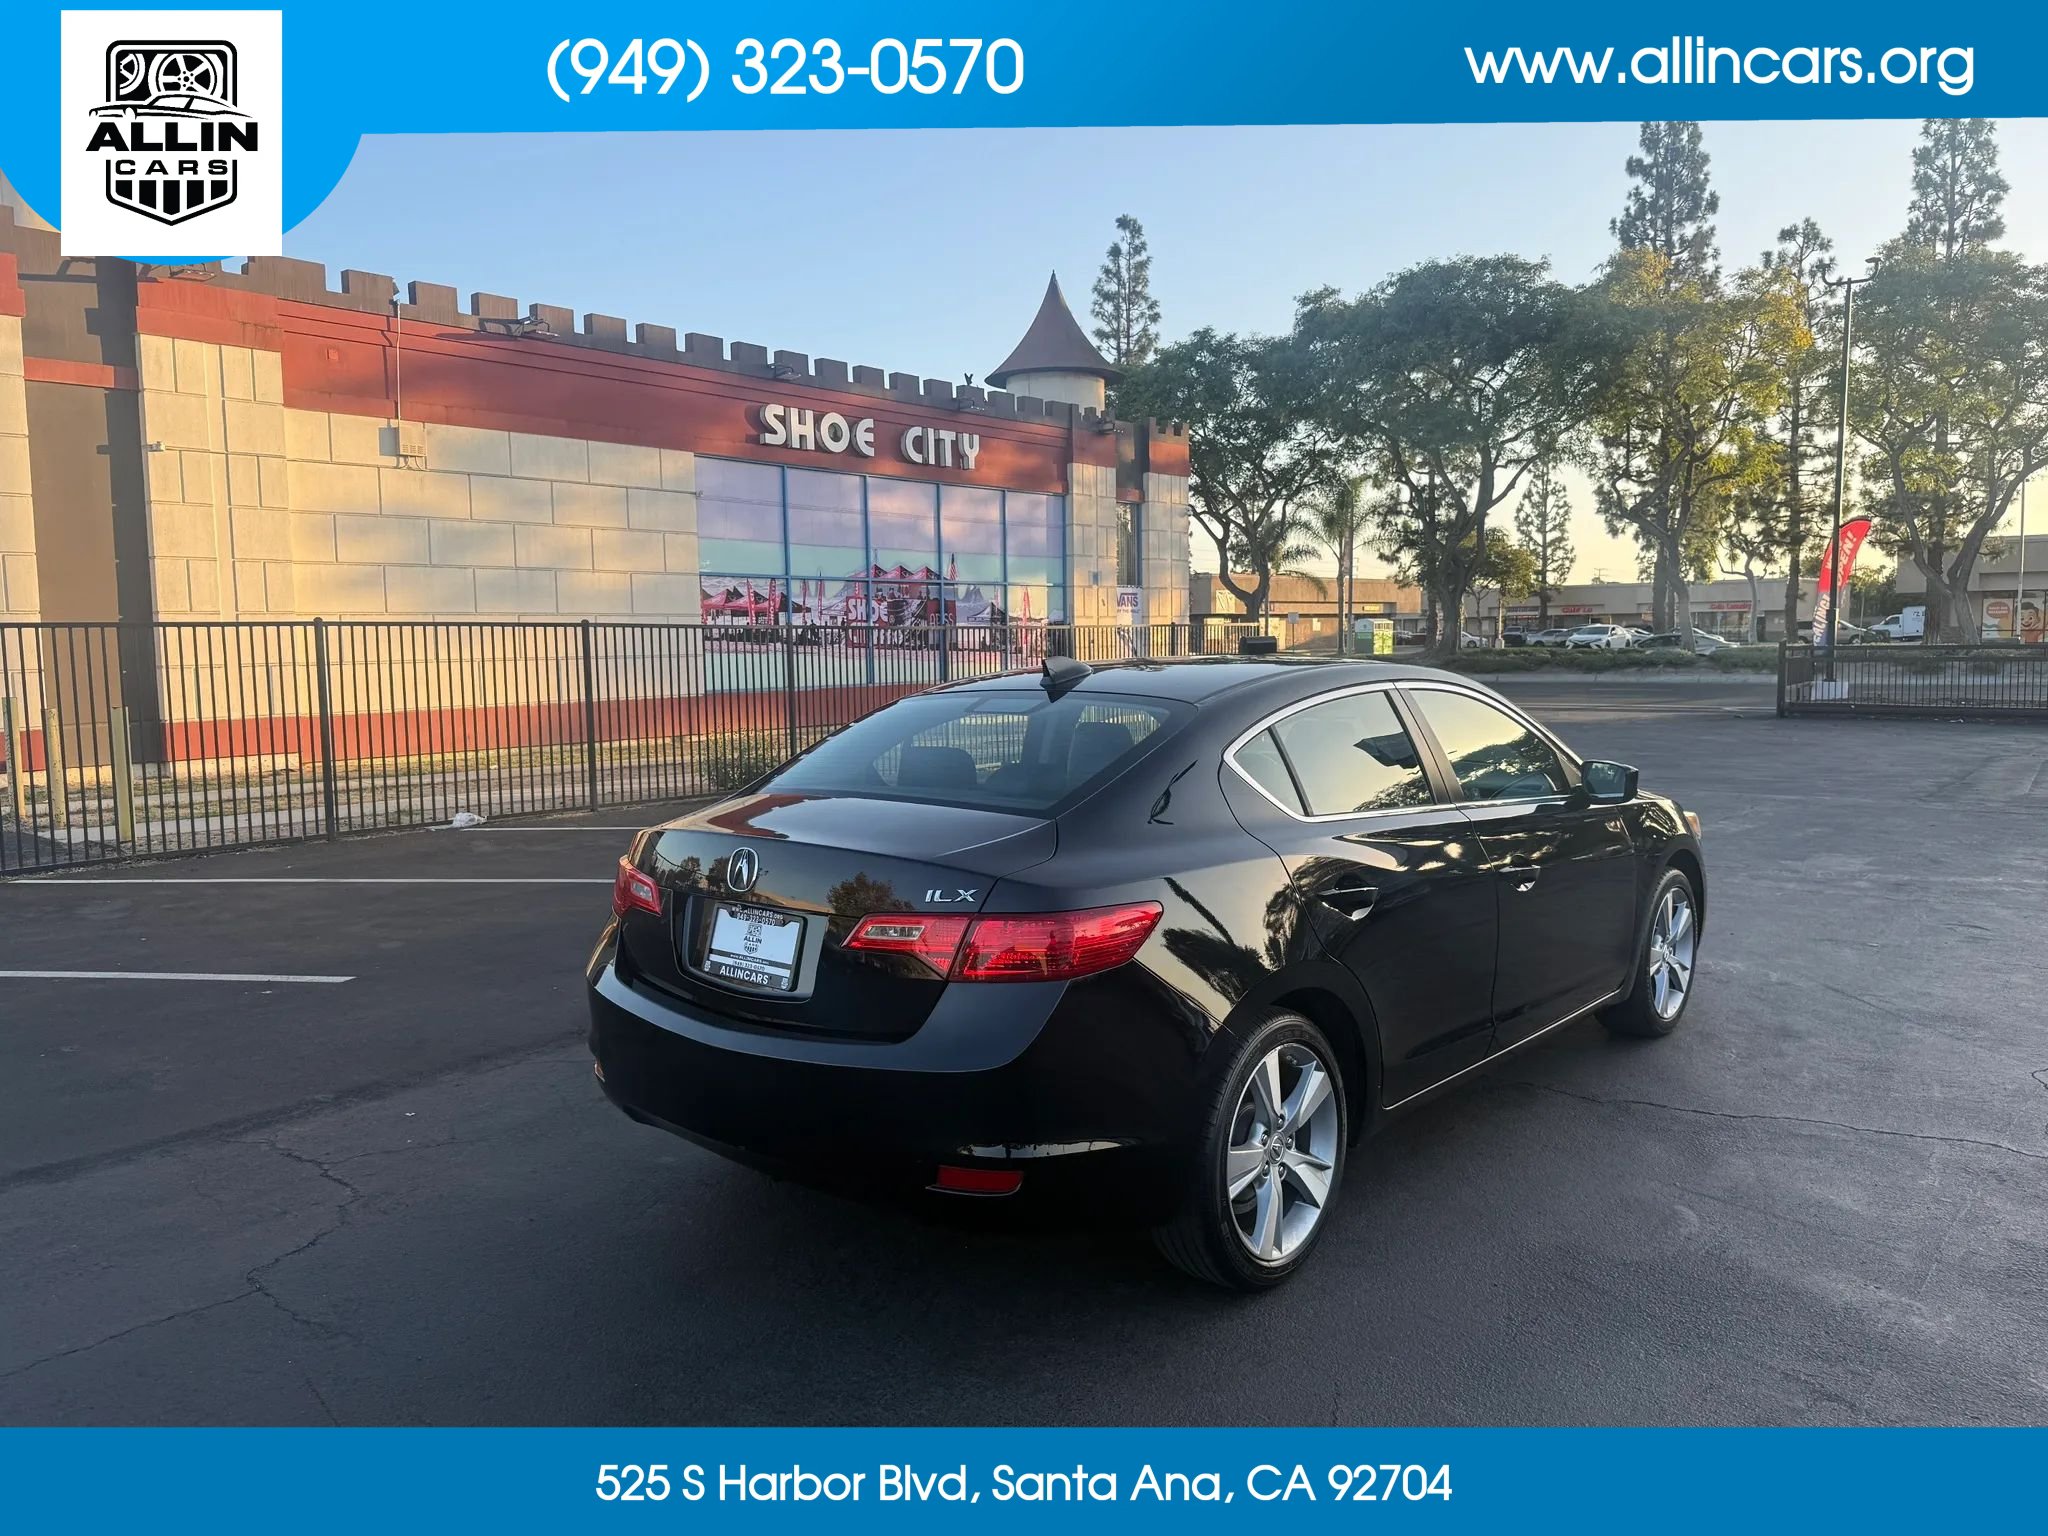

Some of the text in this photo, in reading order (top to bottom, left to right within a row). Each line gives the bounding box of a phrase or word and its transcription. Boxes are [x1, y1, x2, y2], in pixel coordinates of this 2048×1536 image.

[760, 403, 980, 470] SHOE CITY
[1116, 592, 1139, 608] VANS
[925, 889, 979, 902] ILX
[743, 935, 762, 944] ALLIN
[720, 965, 769, 985] ALLINCARS
